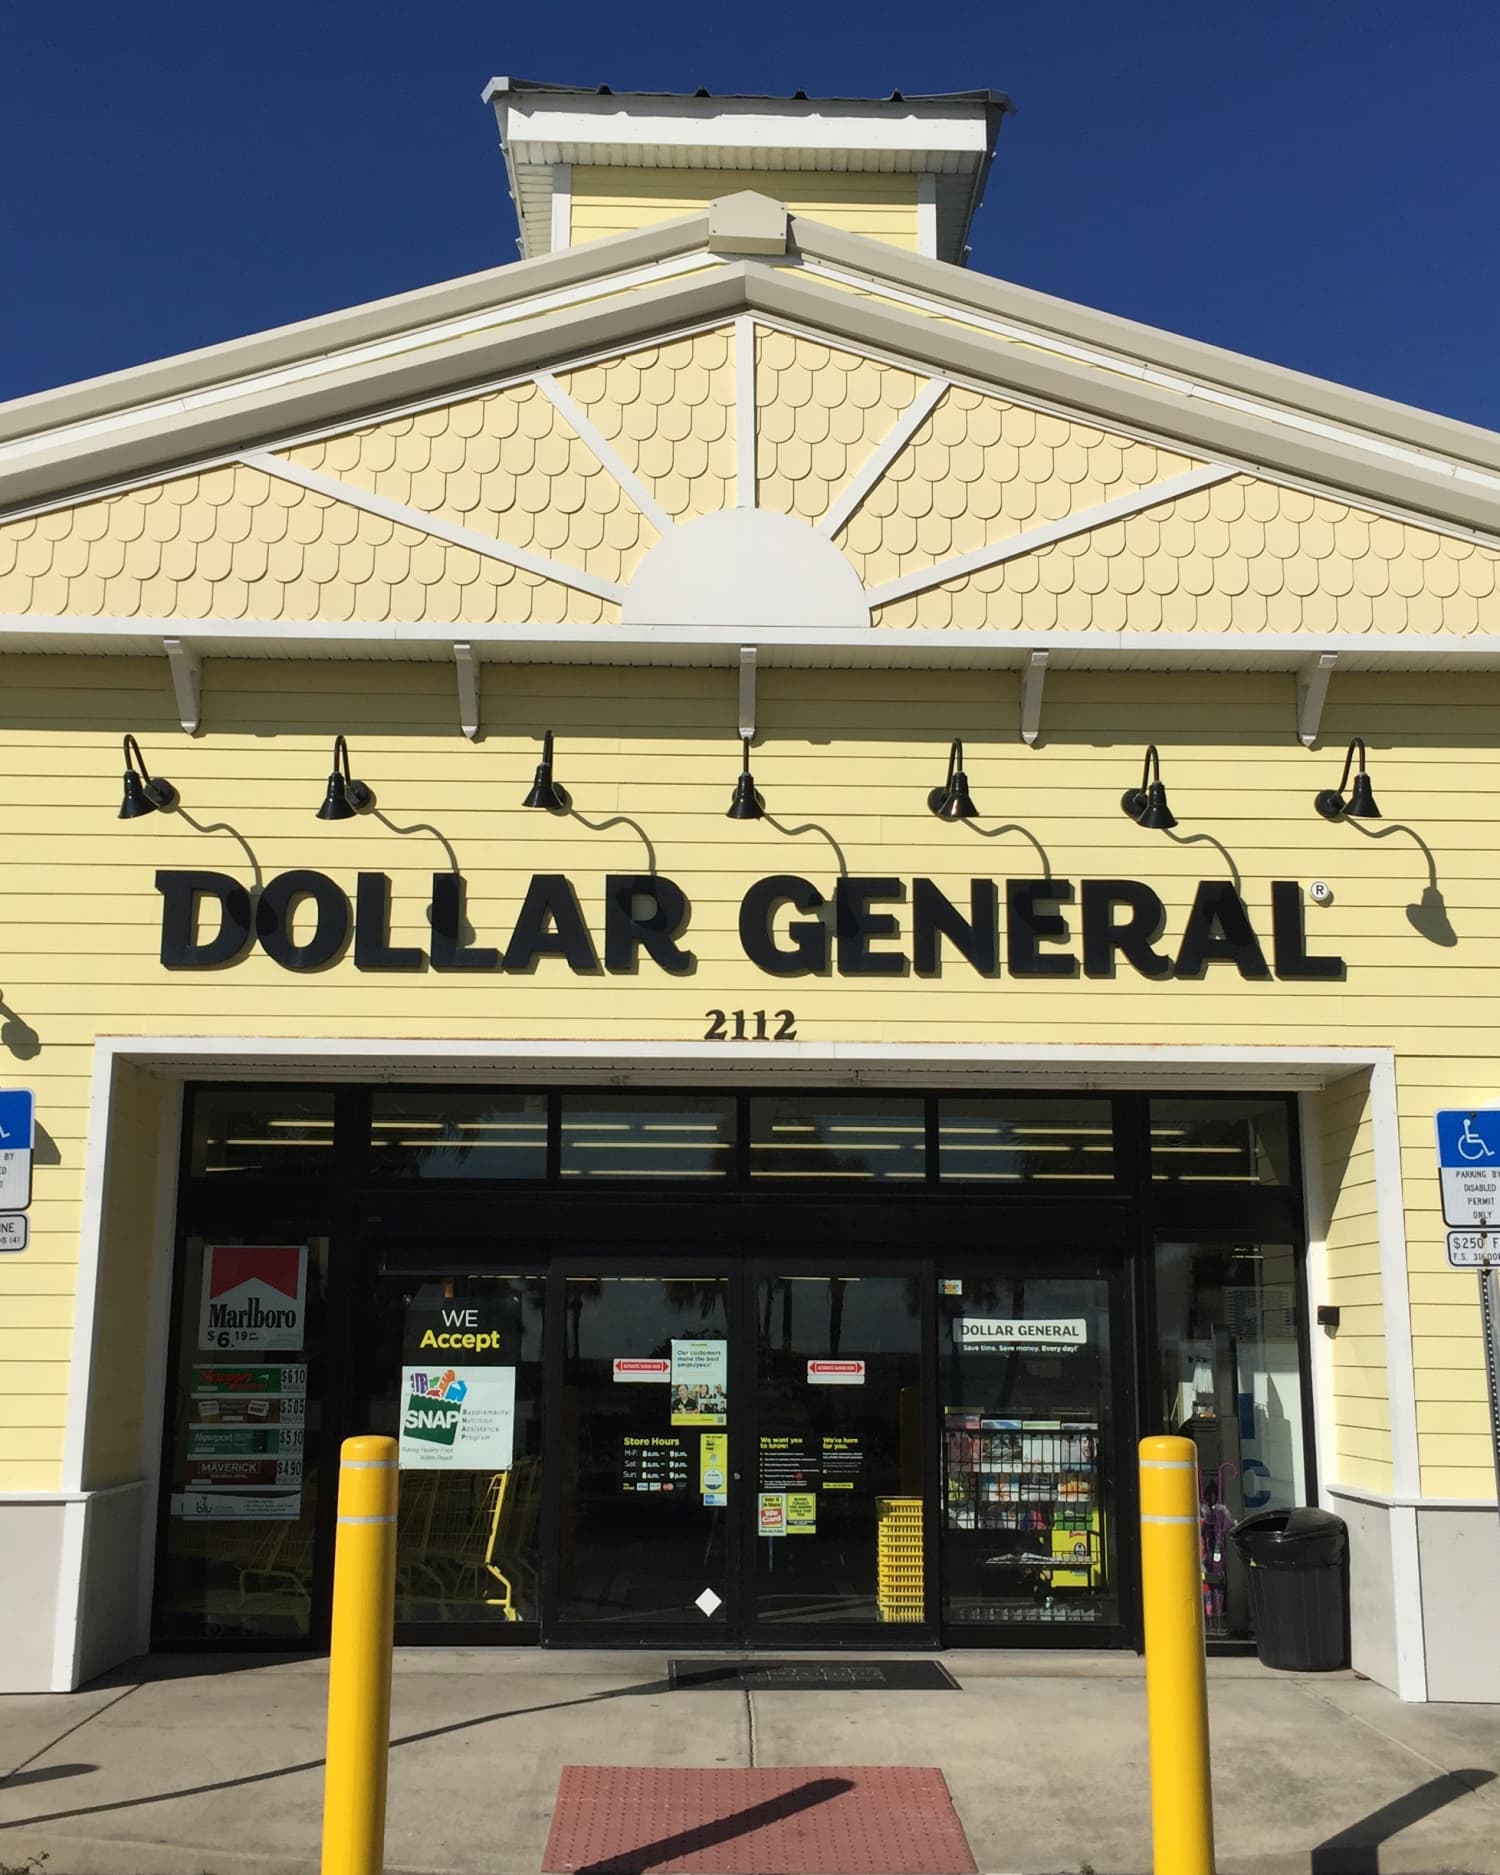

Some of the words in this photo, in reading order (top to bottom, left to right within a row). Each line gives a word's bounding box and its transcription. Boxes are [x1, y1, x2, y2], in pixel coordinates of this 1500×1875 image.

[155, 869, 696, 973] DOLLAR
[739, 875, 1344, 979] GENERAL
[704, 1009, 797, 1041] 2112
[4, 1152, 15, 1160] BY
[1456, 1170, 1487, 1178] PARKING
[1463, 1183, 1497, 1192] DISABLED
[1467, 1197, 1495, 1205] PERMIT
[1472, 1211, 1492, 1219] ONLY
[1453, 1237, 1484, 1249] $250
[208, 1297, 297, 1329] Marlboro
[442, 1309, 479, 1327] WE
[961, 1325, 1014, 1336] DOLLAR
[1018, 1325, 1079, 1337] GENERAL
[419, 1329, 500, 1352] Accept
[405, 1409, 459, 1430] SNAP
[623, 1437, 650, 1446] Store
[652, 1437, 681, 1446] Hours
[202, 1463, 257, 1472] MAVERICK
